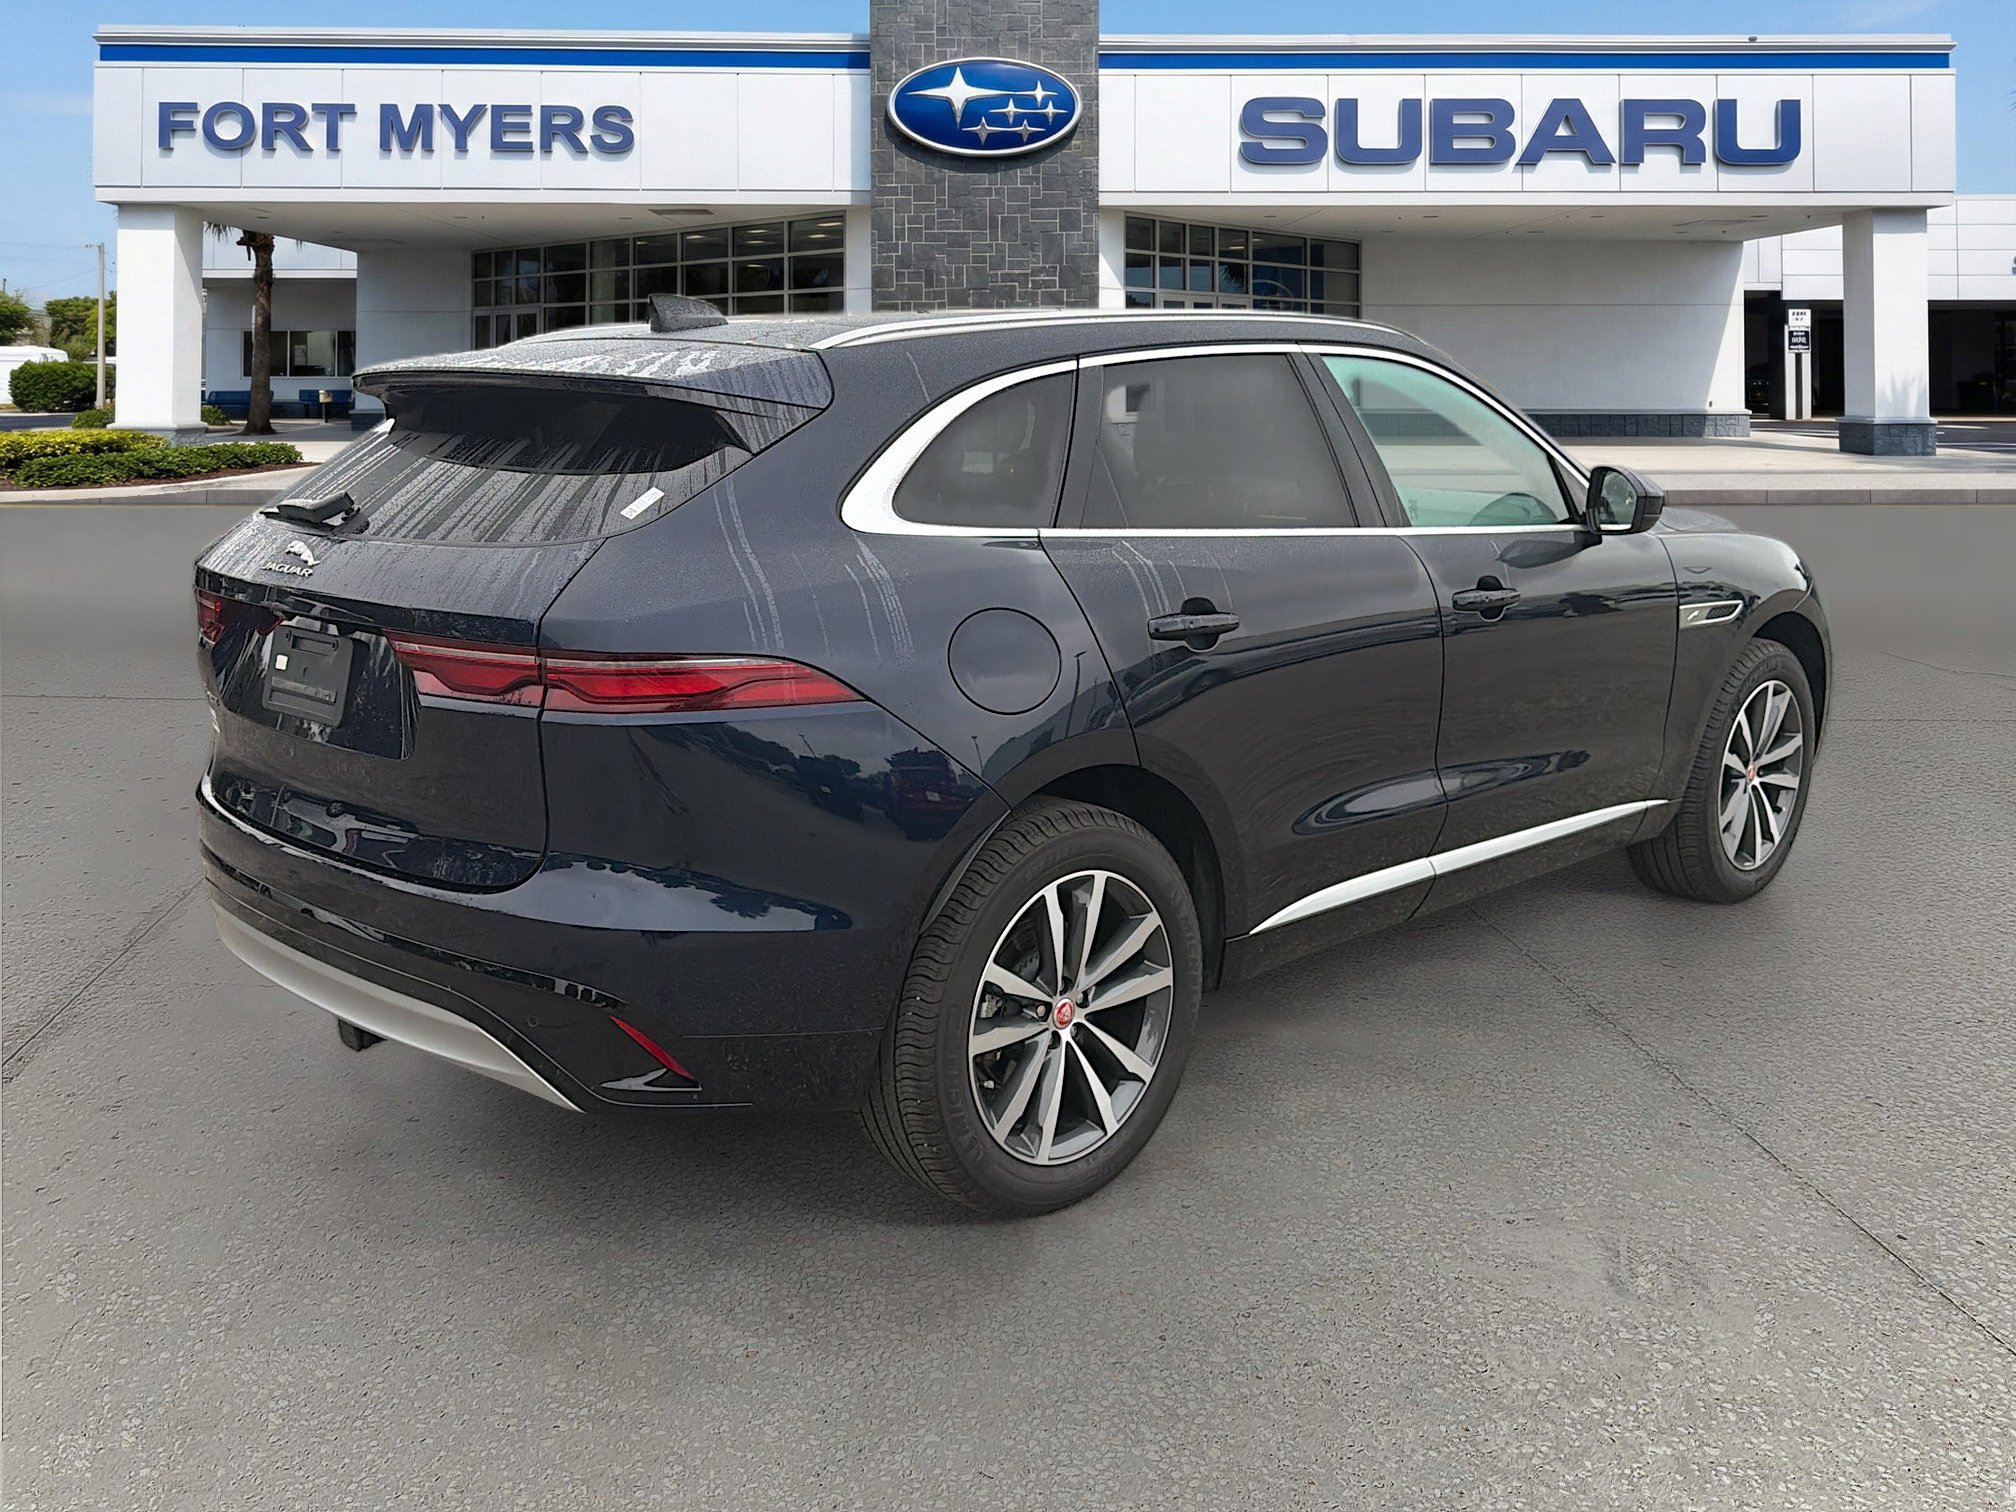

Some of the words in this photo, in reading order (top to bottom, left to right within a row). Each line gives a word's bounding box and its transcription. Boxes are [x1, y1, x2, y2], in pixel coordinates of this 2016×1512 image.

[158, 101, 356, 151] FORT
[379, 103, 634, 153] MYERS
[1240, 97, 1802, 165] SUBARU
[261, 561, 314, 577] JAGUAR
